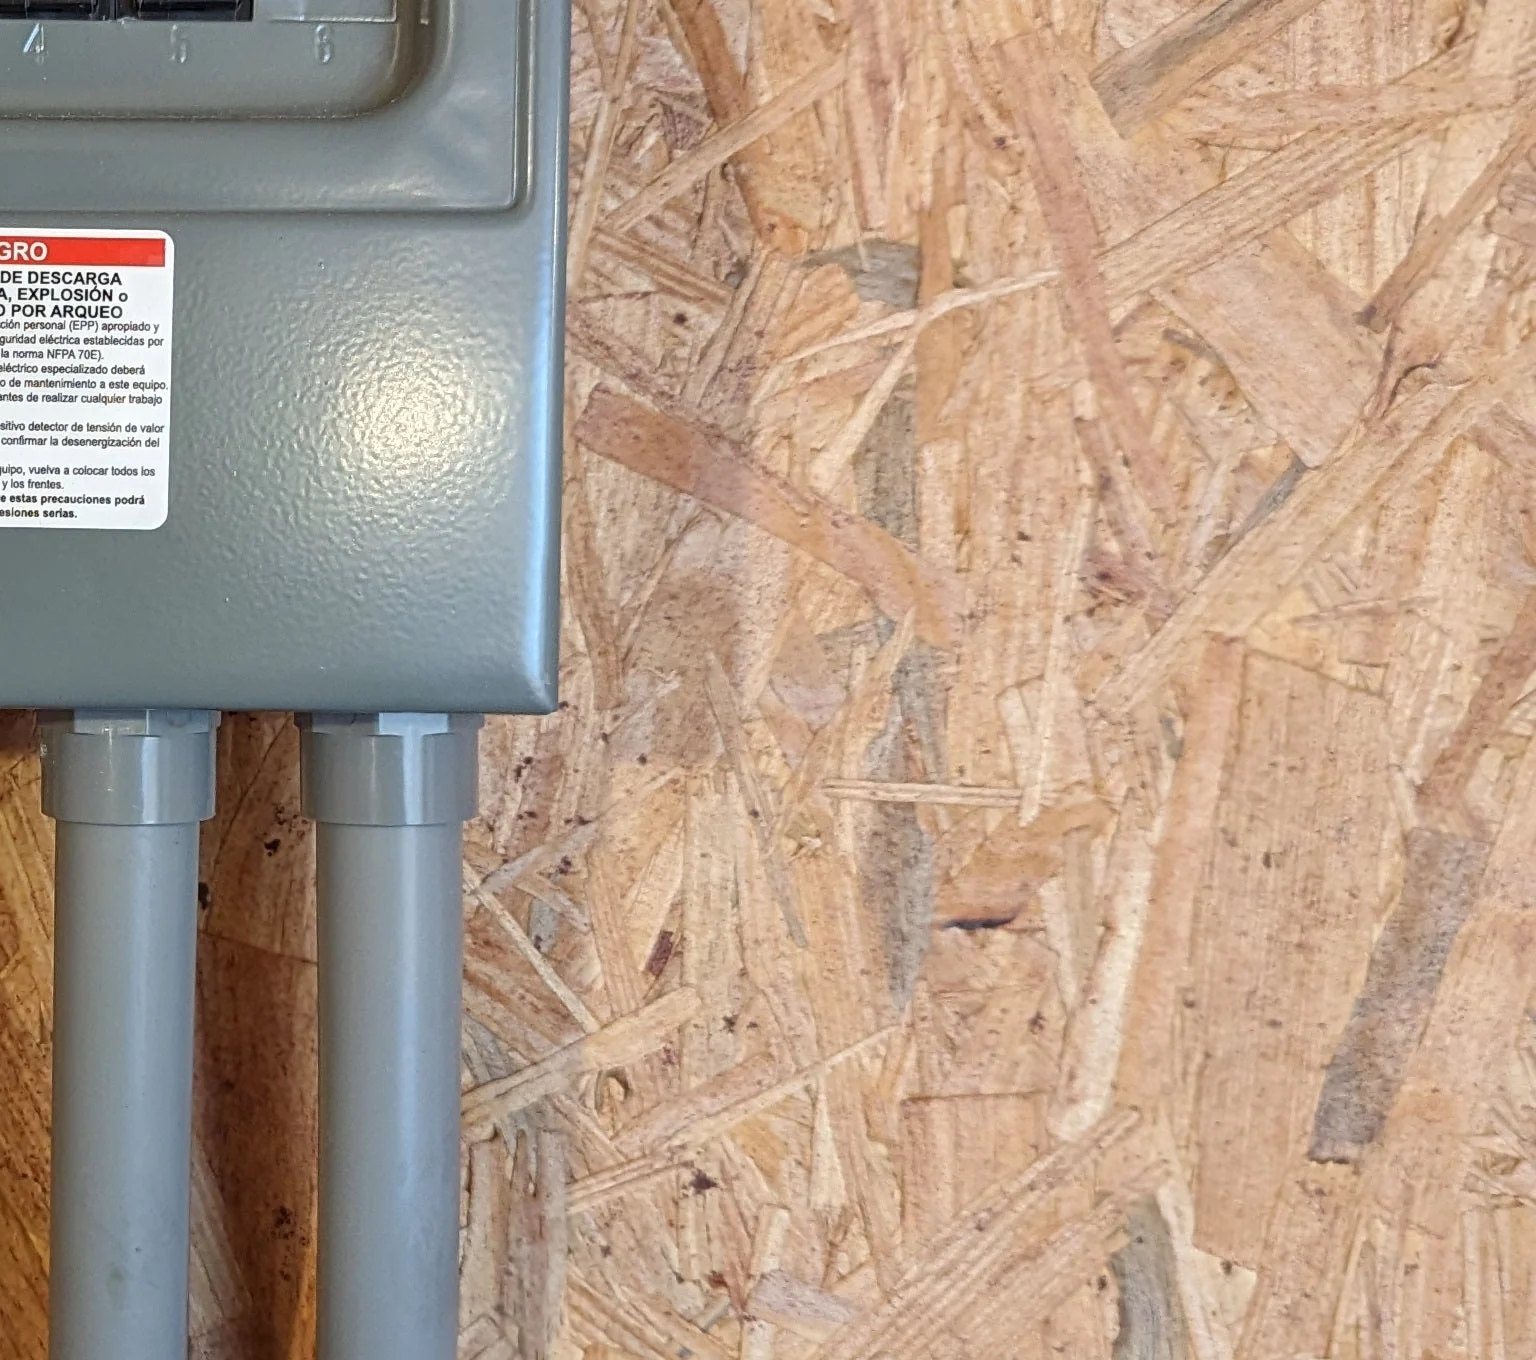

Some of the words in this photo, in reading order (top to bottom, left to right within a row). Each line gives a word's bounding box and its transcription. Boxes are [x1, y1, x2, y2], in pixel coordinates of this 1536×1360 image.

[23, 21, 46, 55] 4
[0, 270, 22, 284] DE
[27, 270, 122, 285] DESCARGA
[16, 287, 113, 301] EXPLOSIÓN
[118, 292, 128, 302] o
[10, 303, 46, 317] POR
[50, 304, 122, 319] ARQUEO
